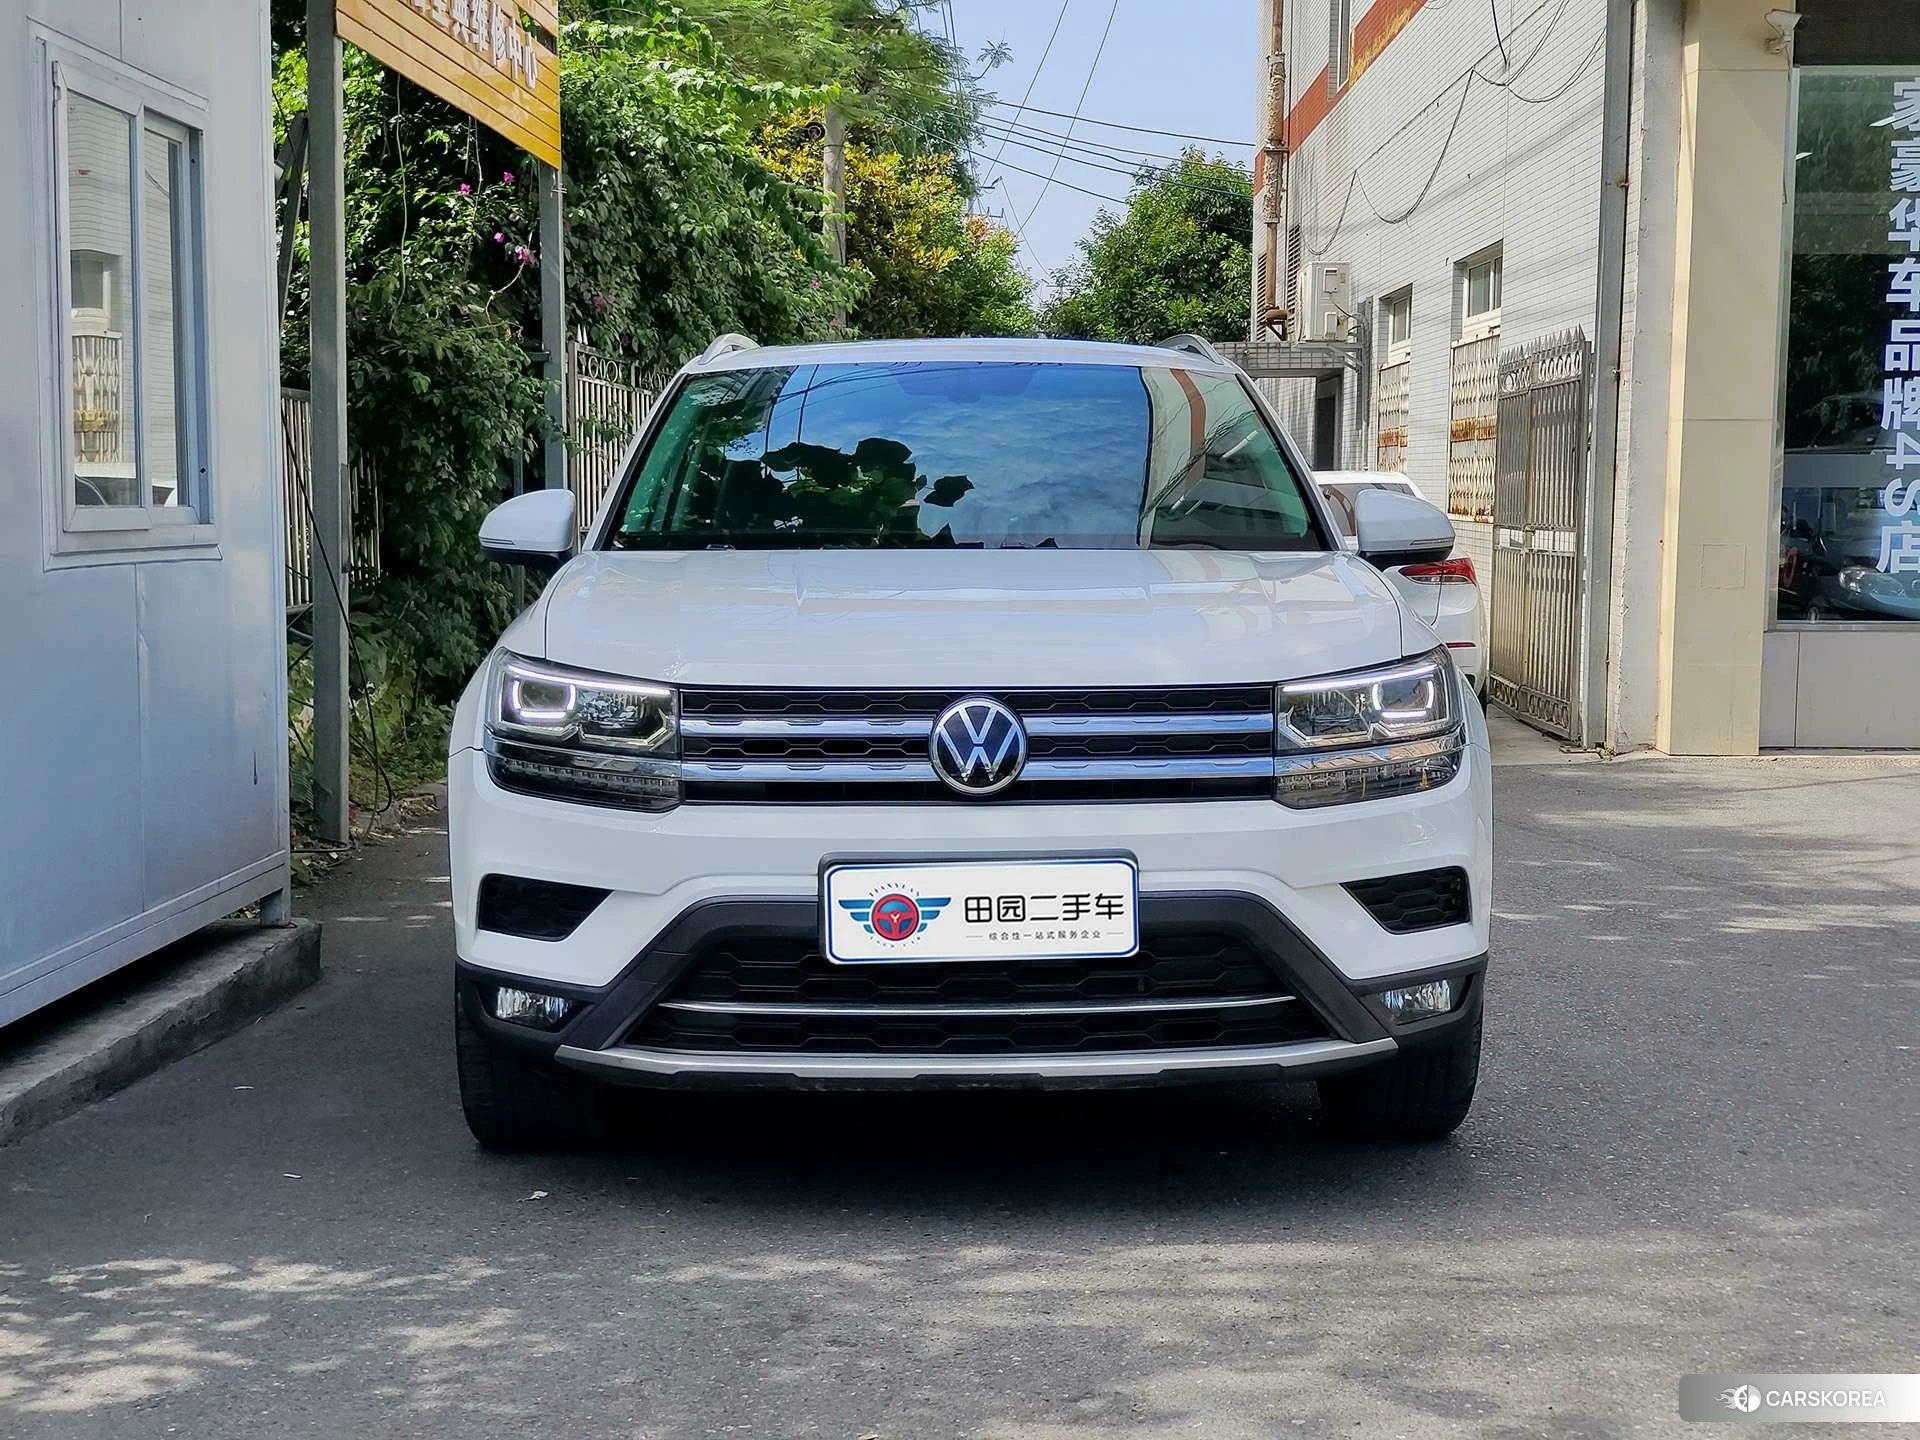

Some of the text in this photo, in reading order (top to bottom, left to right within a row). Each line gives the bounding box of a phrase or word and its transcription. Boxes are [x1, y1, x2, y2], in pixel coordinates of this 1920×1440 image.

[964, 892, 1125, 923] 田园二手车
[988, 929, 1101, 941] 综合性一站式服务企业
